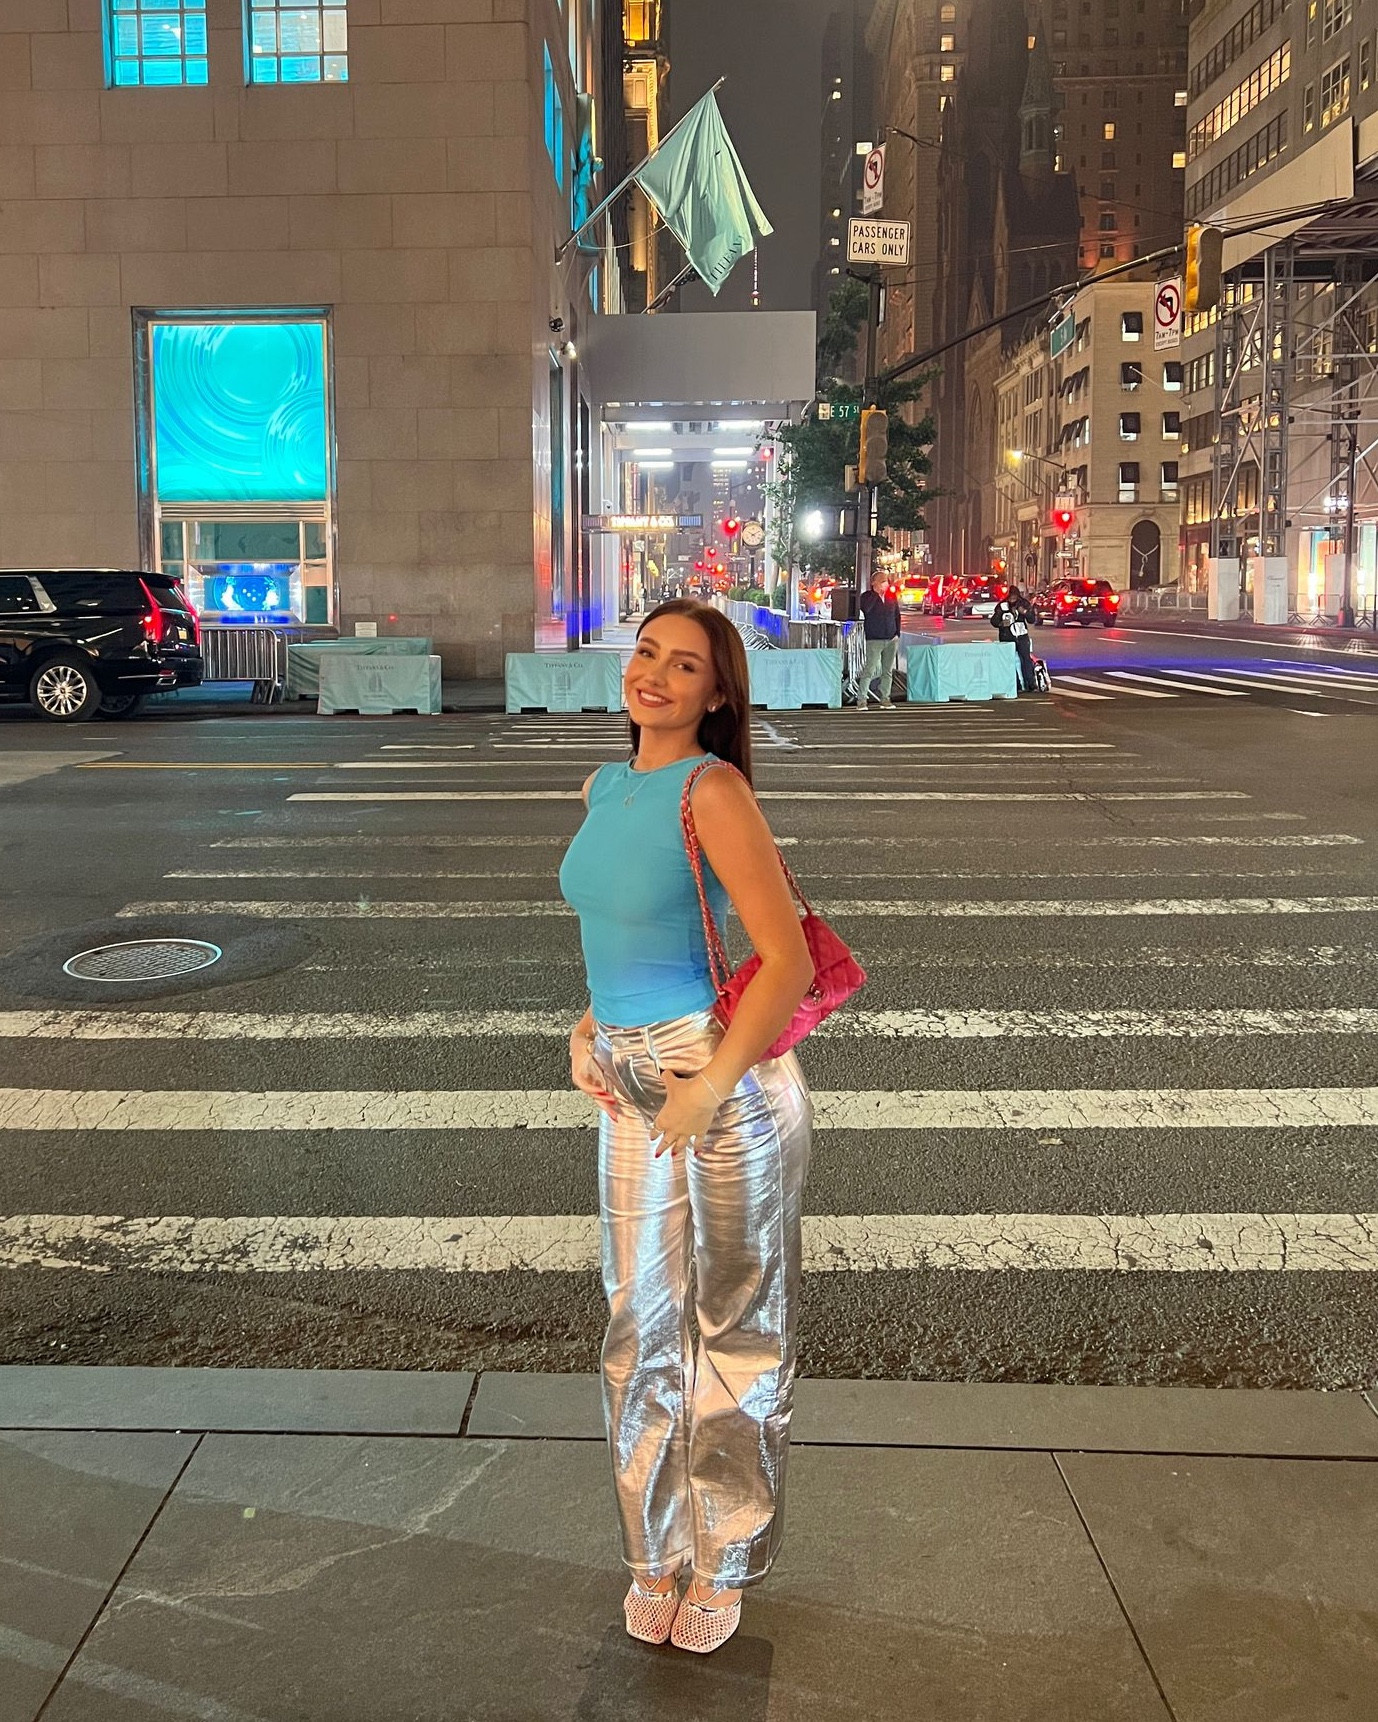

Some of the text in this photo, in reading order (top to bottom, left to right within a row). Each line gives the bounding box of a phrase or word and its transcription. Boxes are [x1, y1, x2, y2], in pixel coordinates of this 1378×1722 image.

[853, 225, 905, 241] PASSENGER
[852, 242, 904, 257] CARS ONLY
[830, 405, 835, 418] E
[839, 405, 849, 418] 57
